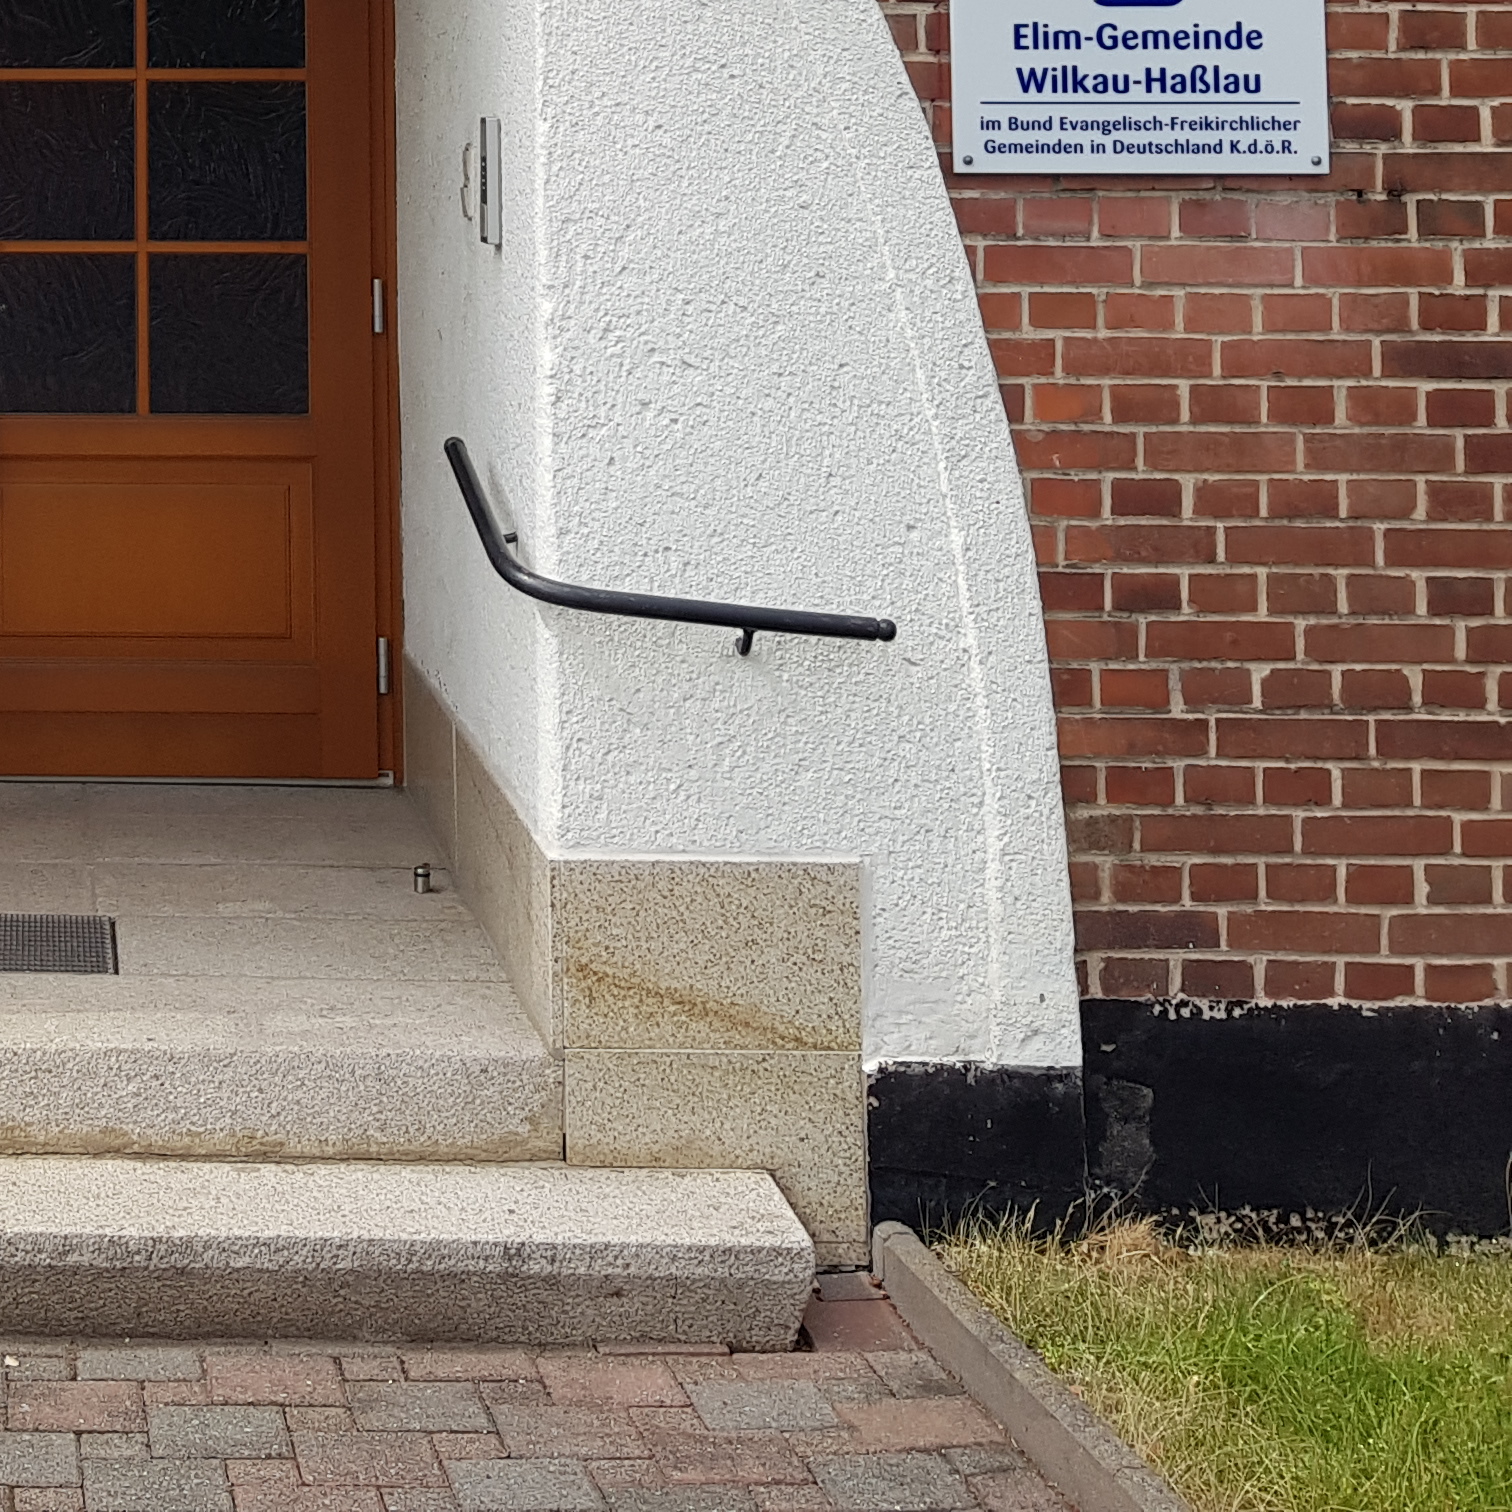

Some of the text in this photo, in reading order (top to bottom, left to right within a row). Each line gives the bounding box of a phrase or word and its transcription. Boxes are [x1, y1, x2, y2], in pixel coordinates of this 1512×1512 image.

[1013, 21, 1264, 51] Elim-Gemeinde
[1015, 64, 1262, 94] Wilkau-Haßlau
[980, 116, 1302, 136] im Bund Evangelisch-Freikirchlicher
[983, 139, 1298, 155] Gemeinden in Deutschland K.d.ö.R.
